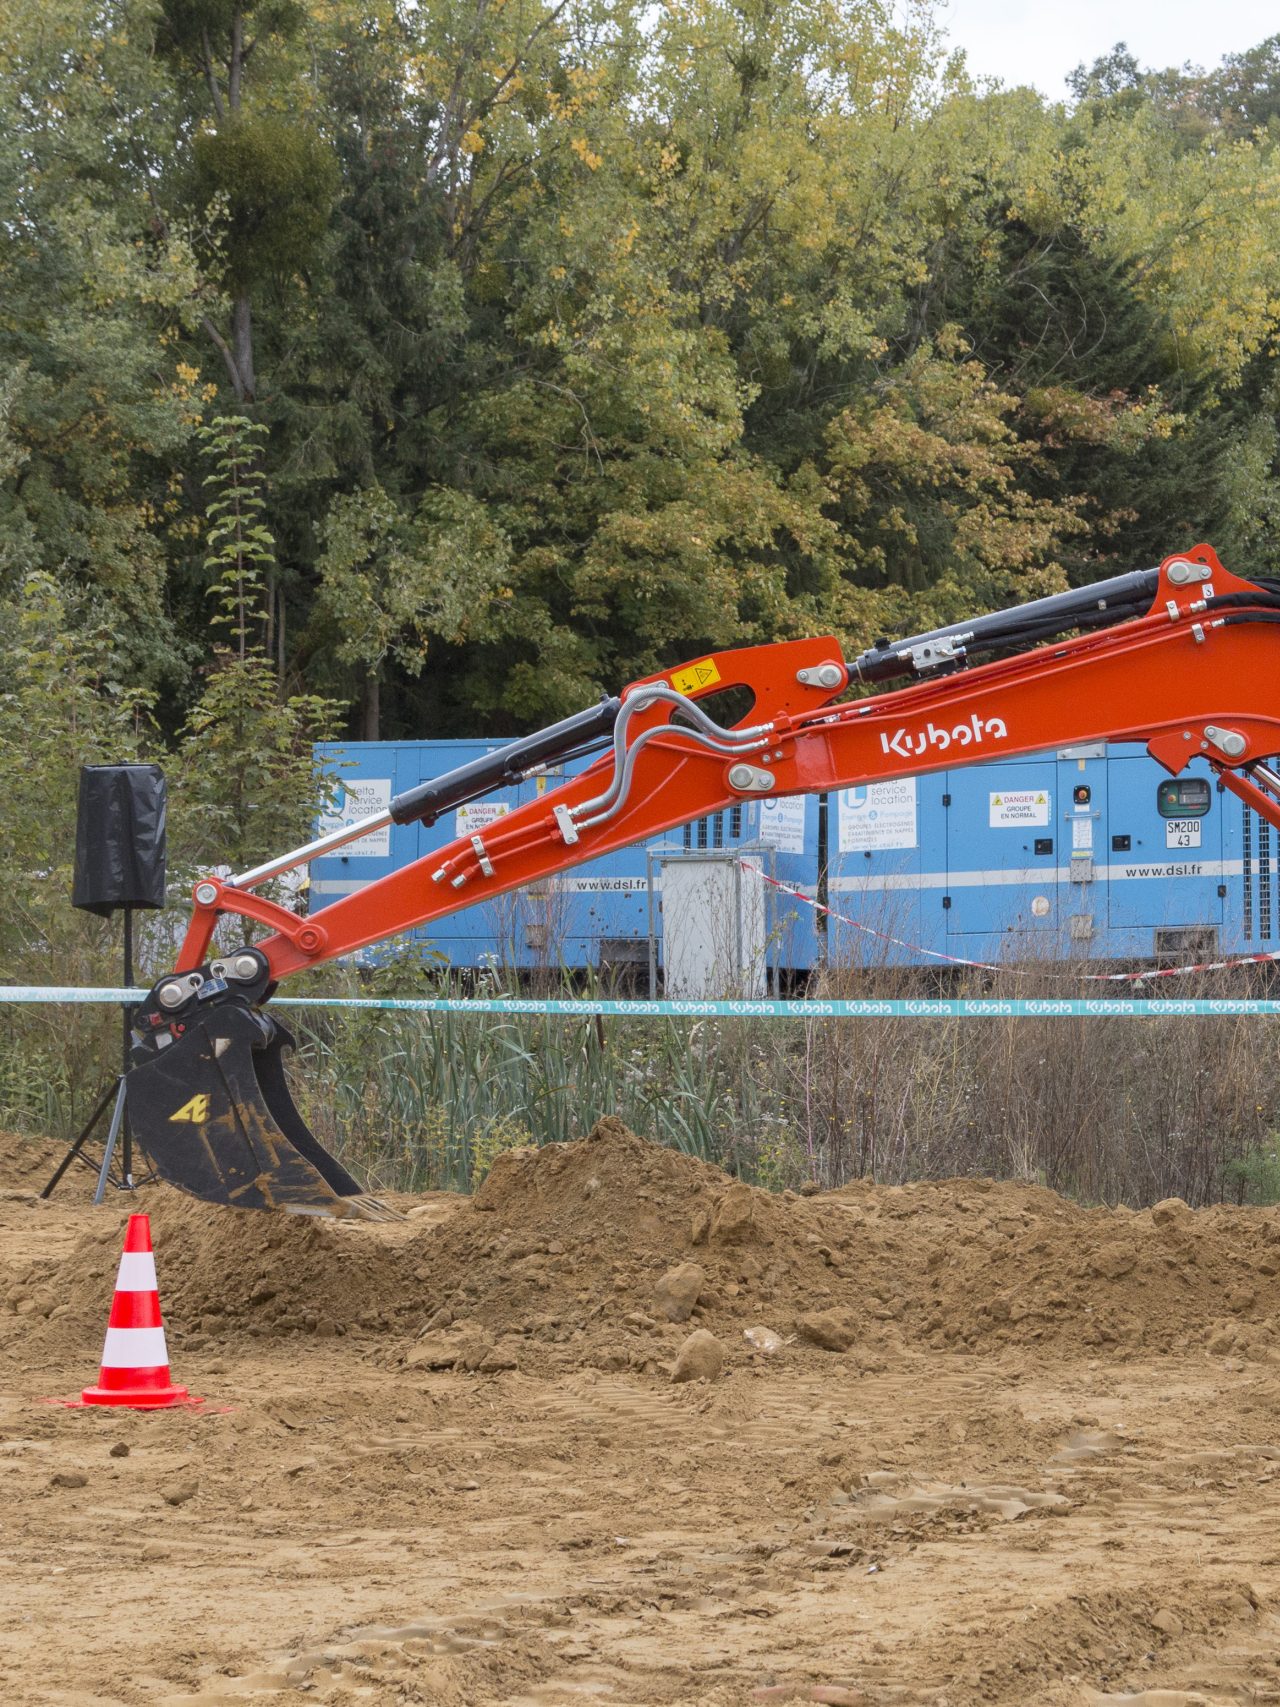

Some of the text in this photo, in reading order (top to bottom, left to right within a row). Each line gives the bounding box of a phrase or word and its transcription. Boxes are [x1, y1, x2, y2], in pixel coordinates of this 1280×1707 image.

[880, 714, 1008, 757] Kubota
[871, 786, 907, 796] service
[349, 797, 382, 805] service
[871, 795, 913, 806] location
[469, 807, 497, 815] DANGER
[1168, 821, 1199, 833] SM200
[1178, 835, 1190, 846] 43
[1126, 864, 1202, 877] www.dsl.fr
[577, 880, 647, 890] www.dsl.fr
[447, 1001, 491, 1010] Kubota
[503, 1001, 546, 1011] Kubota
[559, 1001, 603, 1012] Kubota
[614, 1002, 659, 1012] Kubota
[671, 1002, 717, 1012] Kubota
[729, 1002, 774, 1013] Kubota
[787, 1002, 833, 1013] Kubota
[846, 1002, 892, 1013] Kubota
[905, 1002, 951, 1013] Kubota
[965, 1002, 1011, 1013] Kubota
[1025, 1001, 1072, 1013] Kubota
[1086, 1001, 1133, 1012] Kubota
[1147, 1001, 1195, 1012] Kubota
[1210, 1001, 1258, 1012] Kubota
